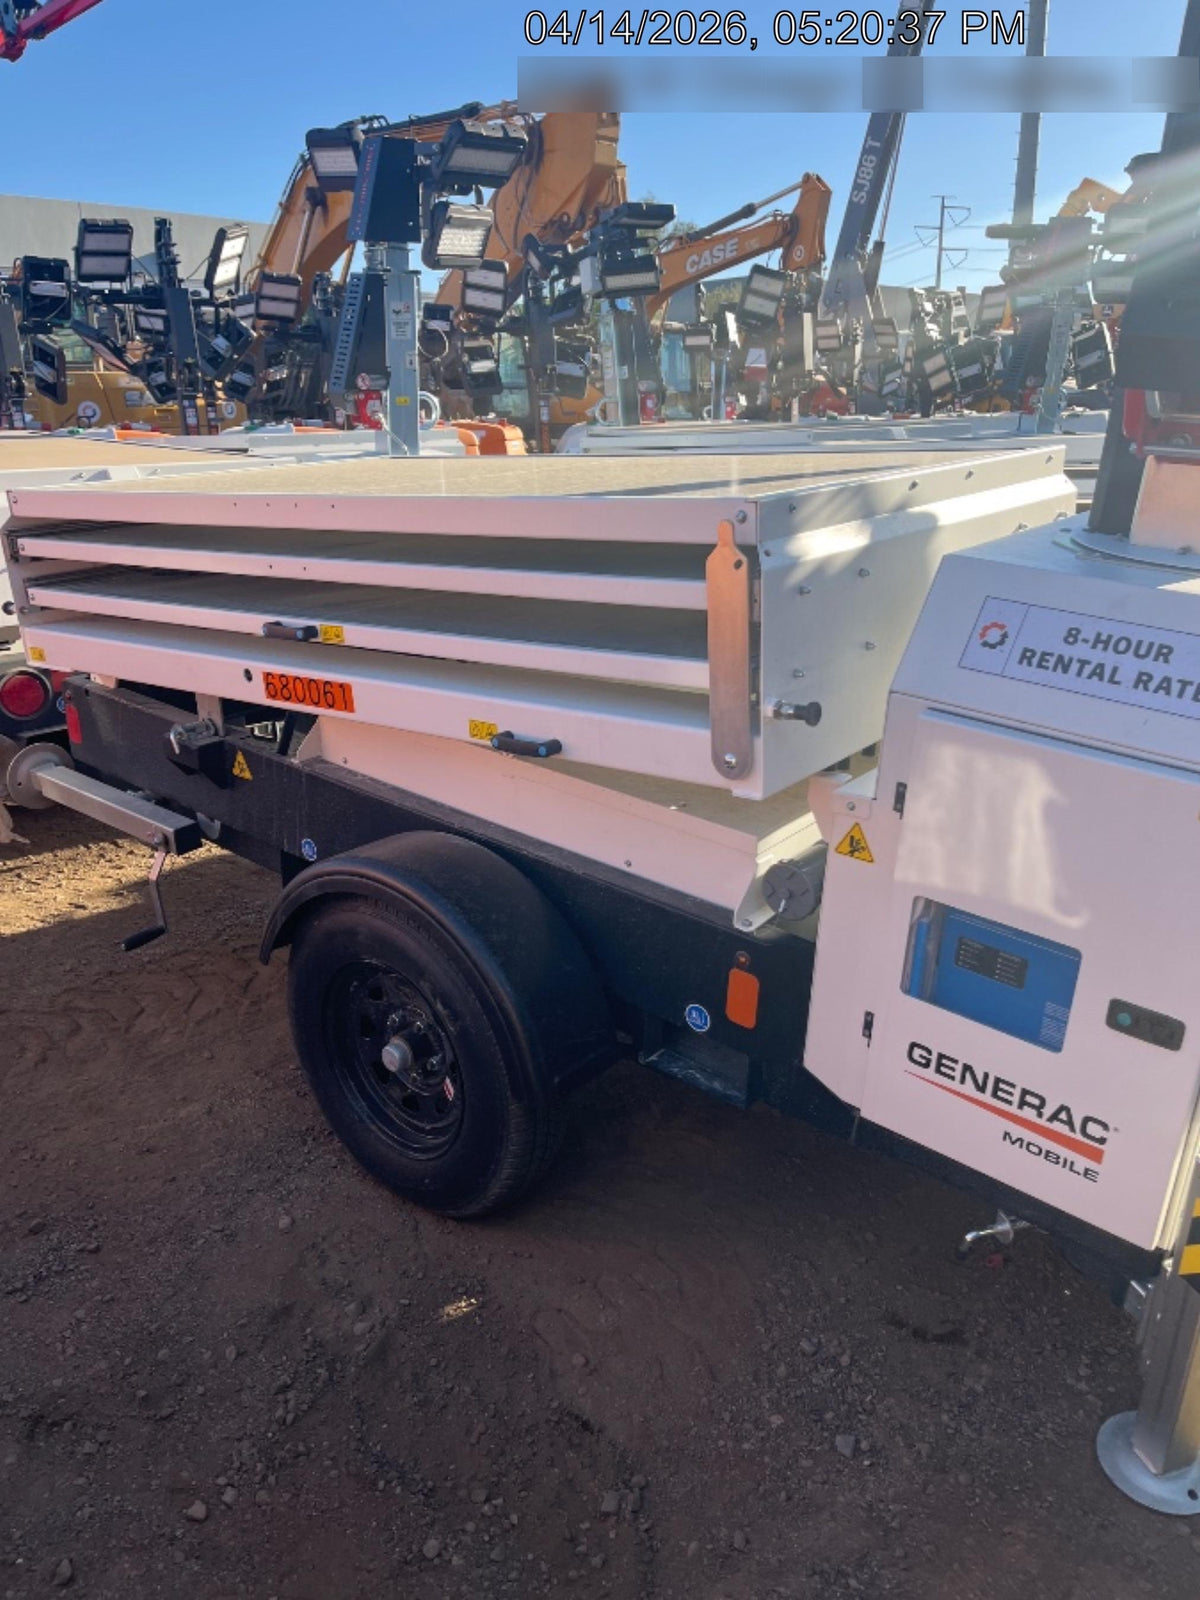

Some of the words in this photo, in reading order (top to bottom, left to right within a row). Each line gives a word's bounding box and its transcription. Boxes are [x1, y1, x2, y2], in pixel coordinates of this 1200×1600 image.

[851, 154, 877, 204] SJ86
[685, 237, 739, 275] CASE
[1062, 626, 1174, 664] 8-HOUR
[1017, 646, 1122, 686] RENTAL
[265, 671, 348, 710] 680061
[906, 1040, 1110, 1146] GENERAC
[1002, 1130, 1100, 1183] MOBILE
